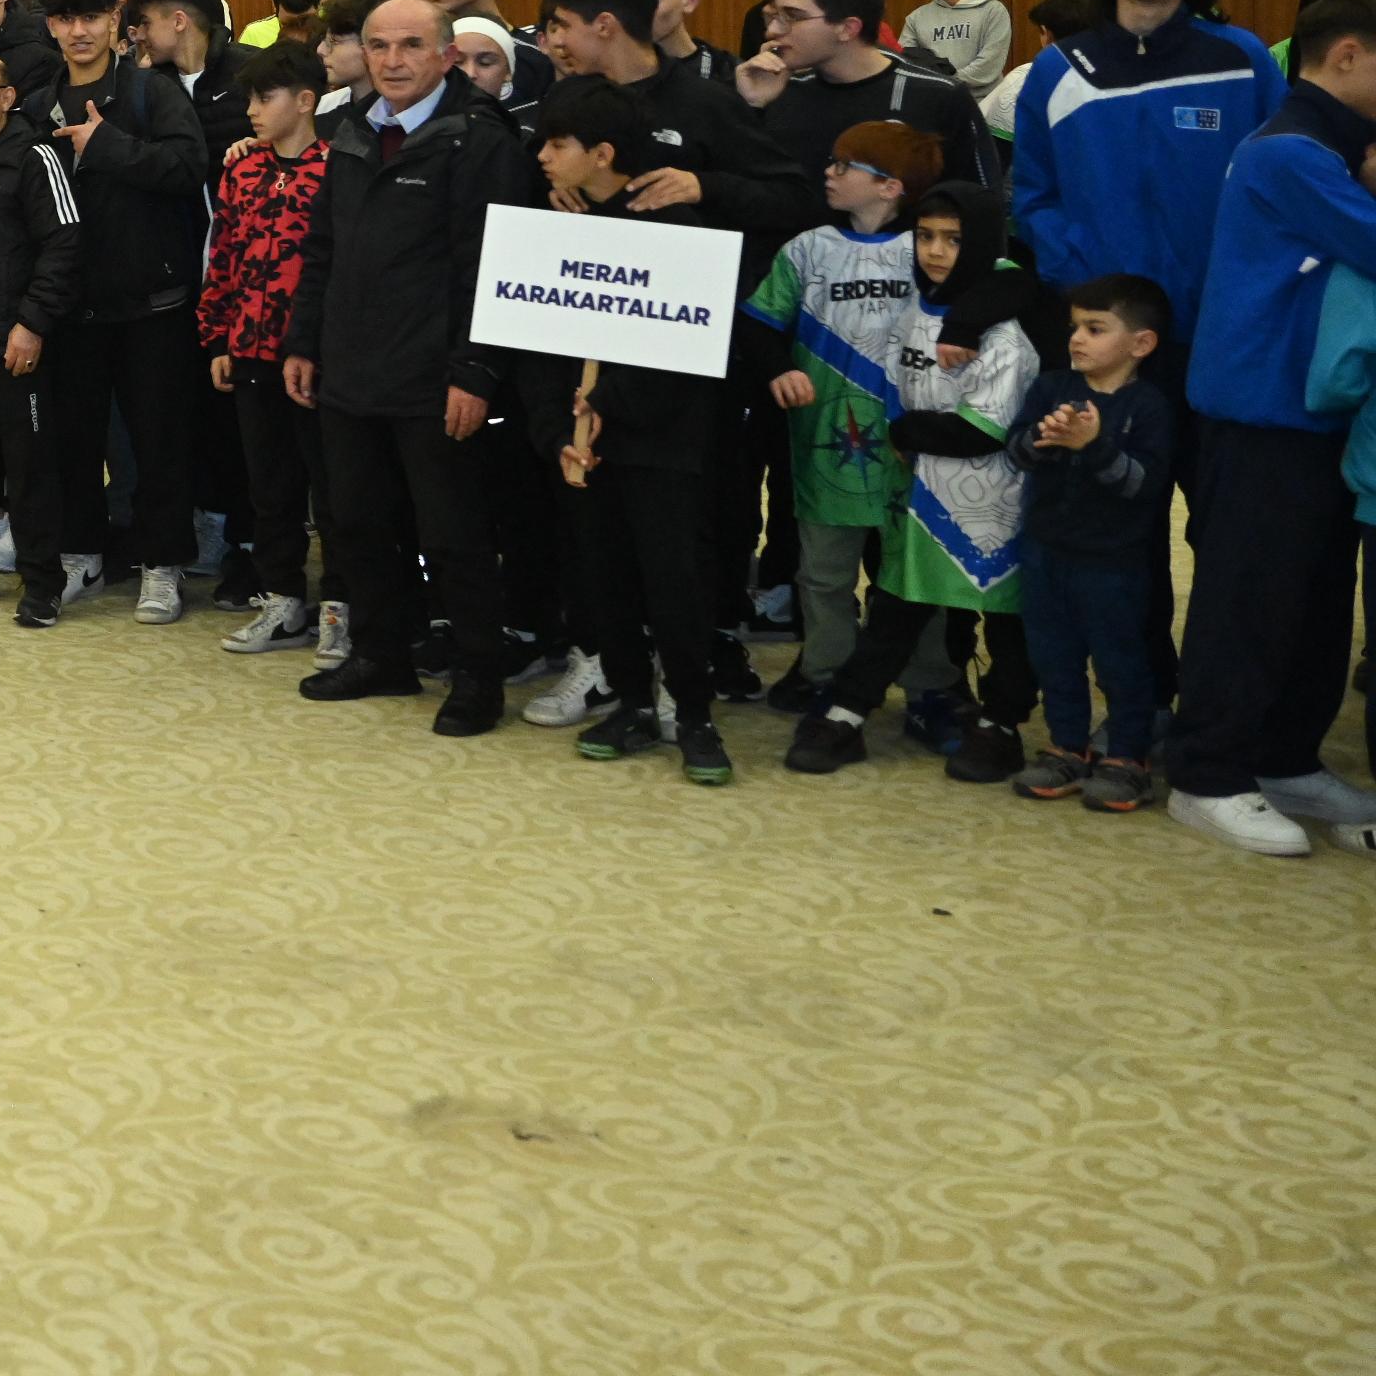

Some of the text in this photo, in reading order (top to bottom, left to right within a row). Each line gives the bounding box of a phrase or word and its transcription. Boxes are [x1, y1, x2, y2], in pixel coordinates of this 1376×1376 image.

[933, 21, 971, 41] MAVİ
[560, 259, 651, 287] MERAM
[496, 280, 711, 327] KARAKARTALLAR
